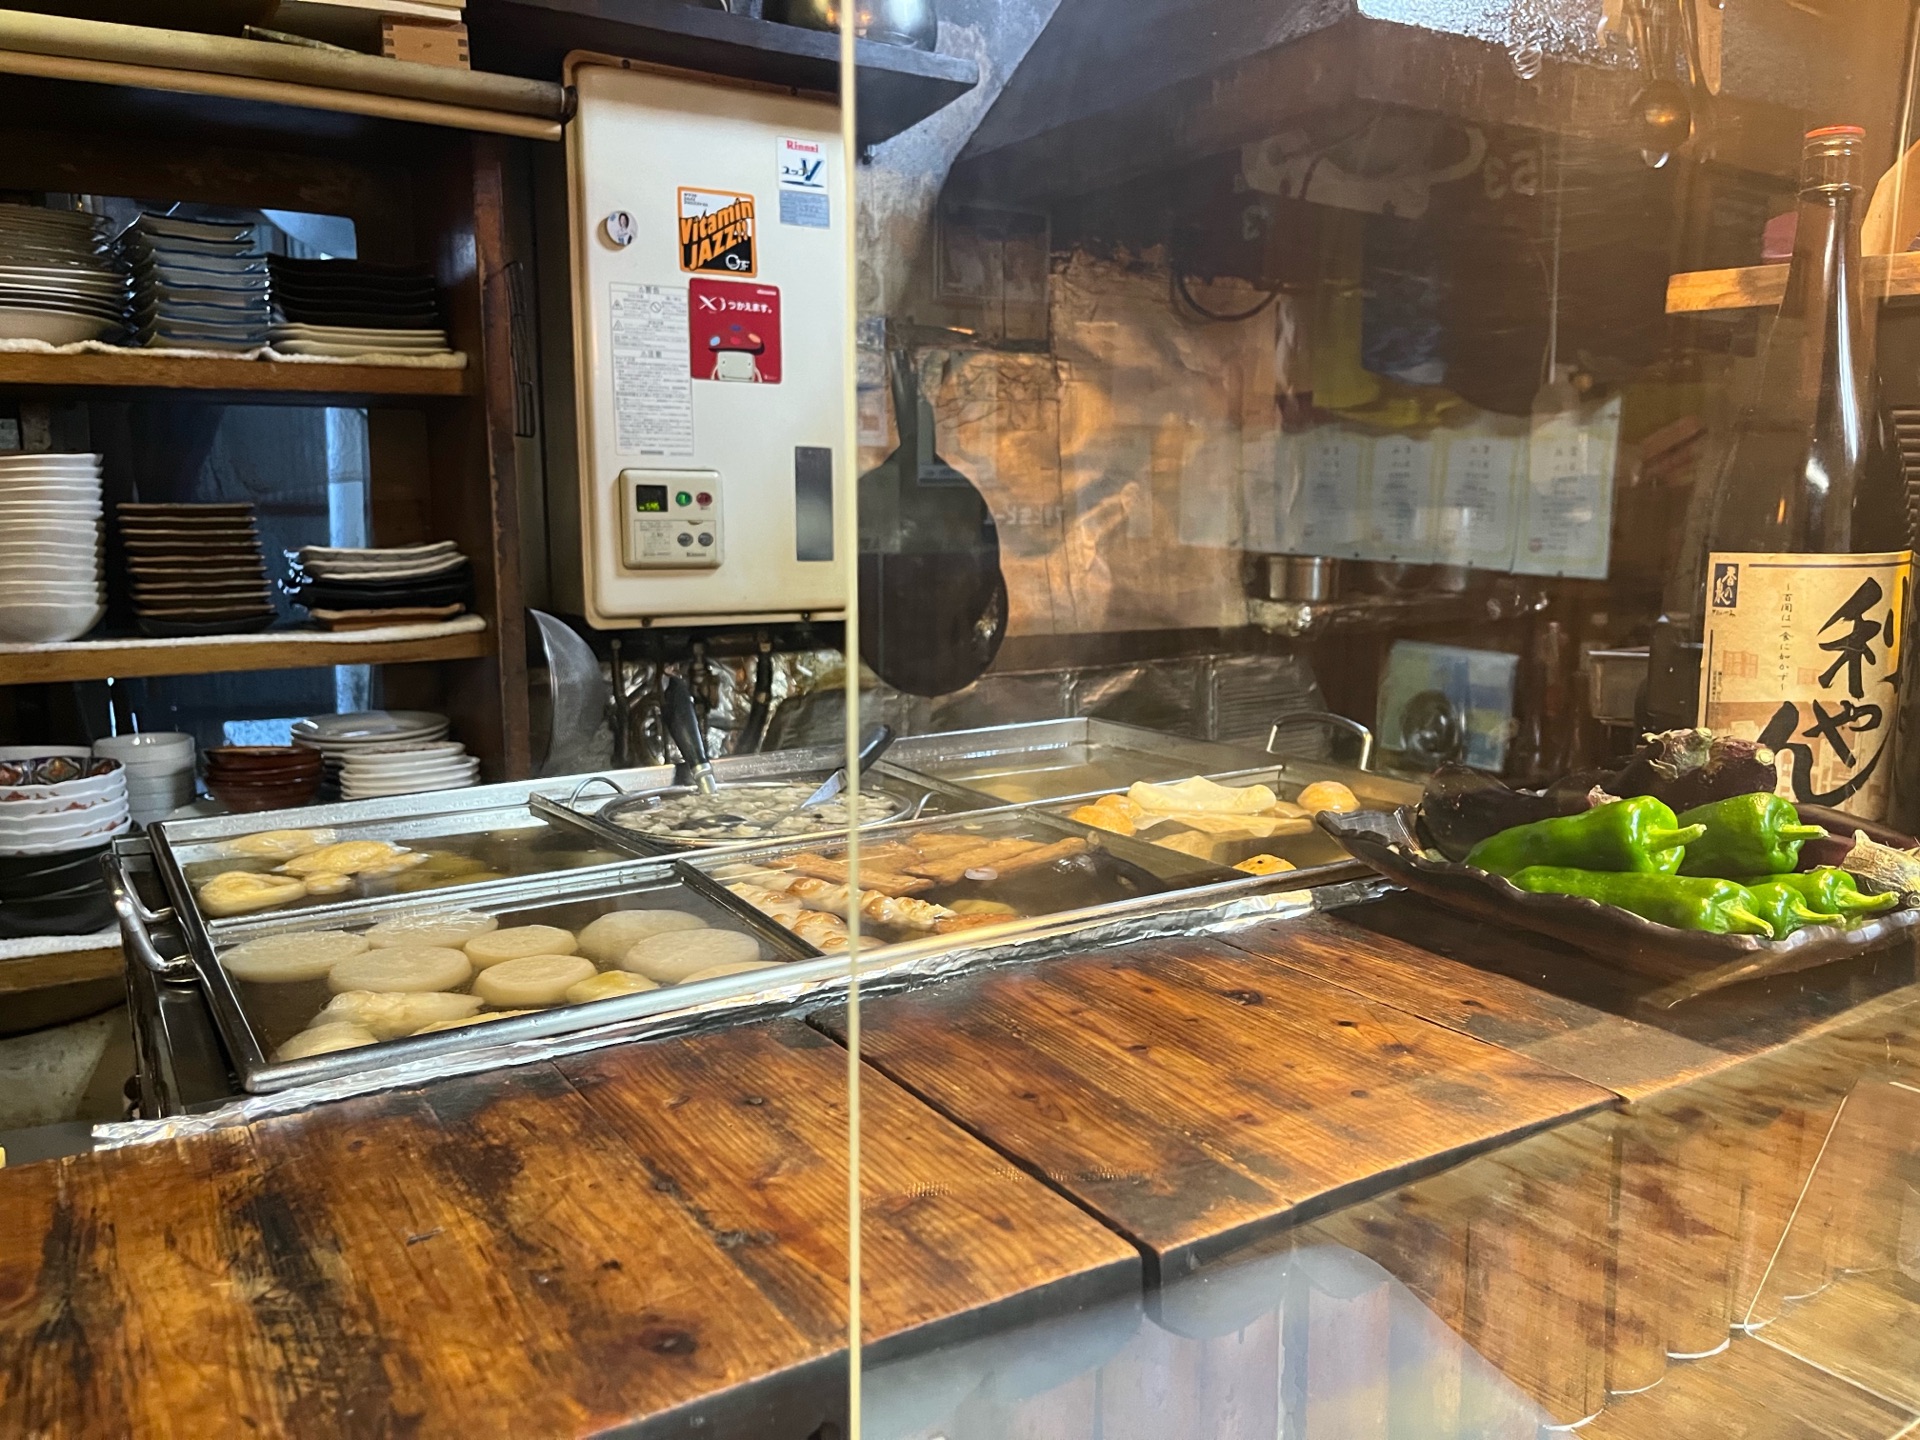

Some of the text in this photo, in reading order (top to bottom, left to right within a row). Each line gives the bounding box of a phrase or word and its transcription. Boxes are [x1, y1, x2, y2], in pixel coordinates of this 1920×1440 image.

[786, 140, 819, 153] Rinnai
[679, 197, 755, 246] Vitamin
[688, 220, 749, 271] JAZZ!!
[1756, 576, 1909, 807] 利やん
